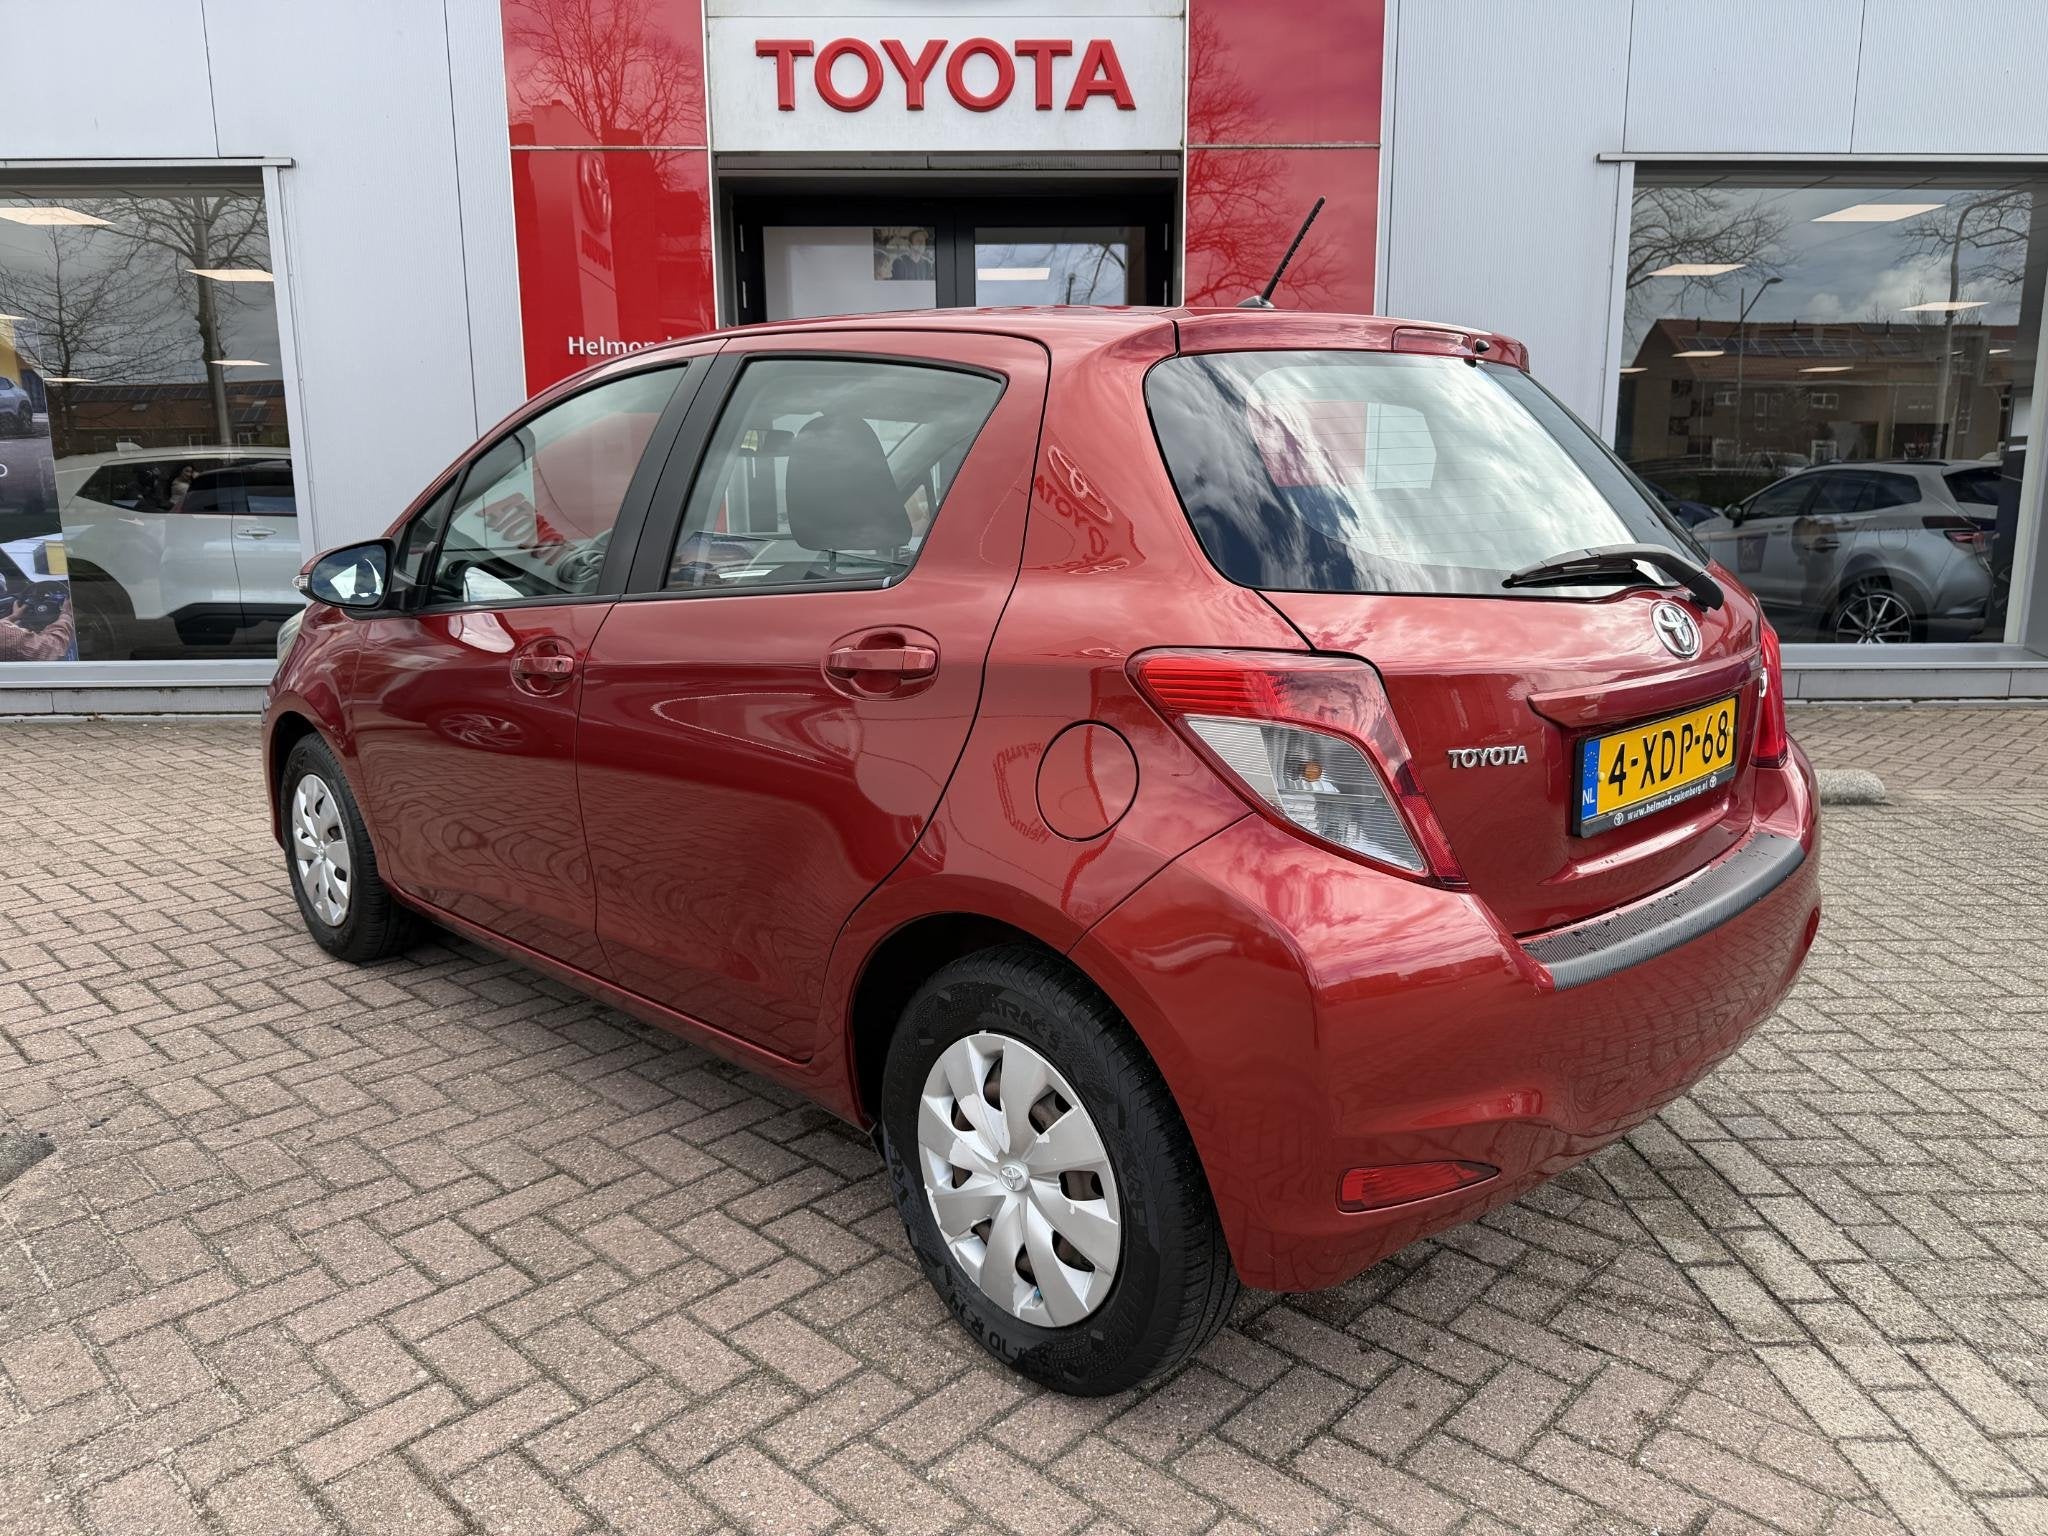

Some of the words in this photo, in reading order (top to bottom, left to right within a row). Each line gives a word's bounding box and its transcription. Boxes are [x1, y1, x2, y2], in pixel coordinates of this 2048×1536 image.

[755, 37, 1137, 113] TOYOTA
[568, 335, 673, 356] Helmo
[1448, 745, 1529, 769] TOYOTA
[1608, 709, 1728, 797] 4-XDP-68
[1582, 787, 1595, 806] NL
